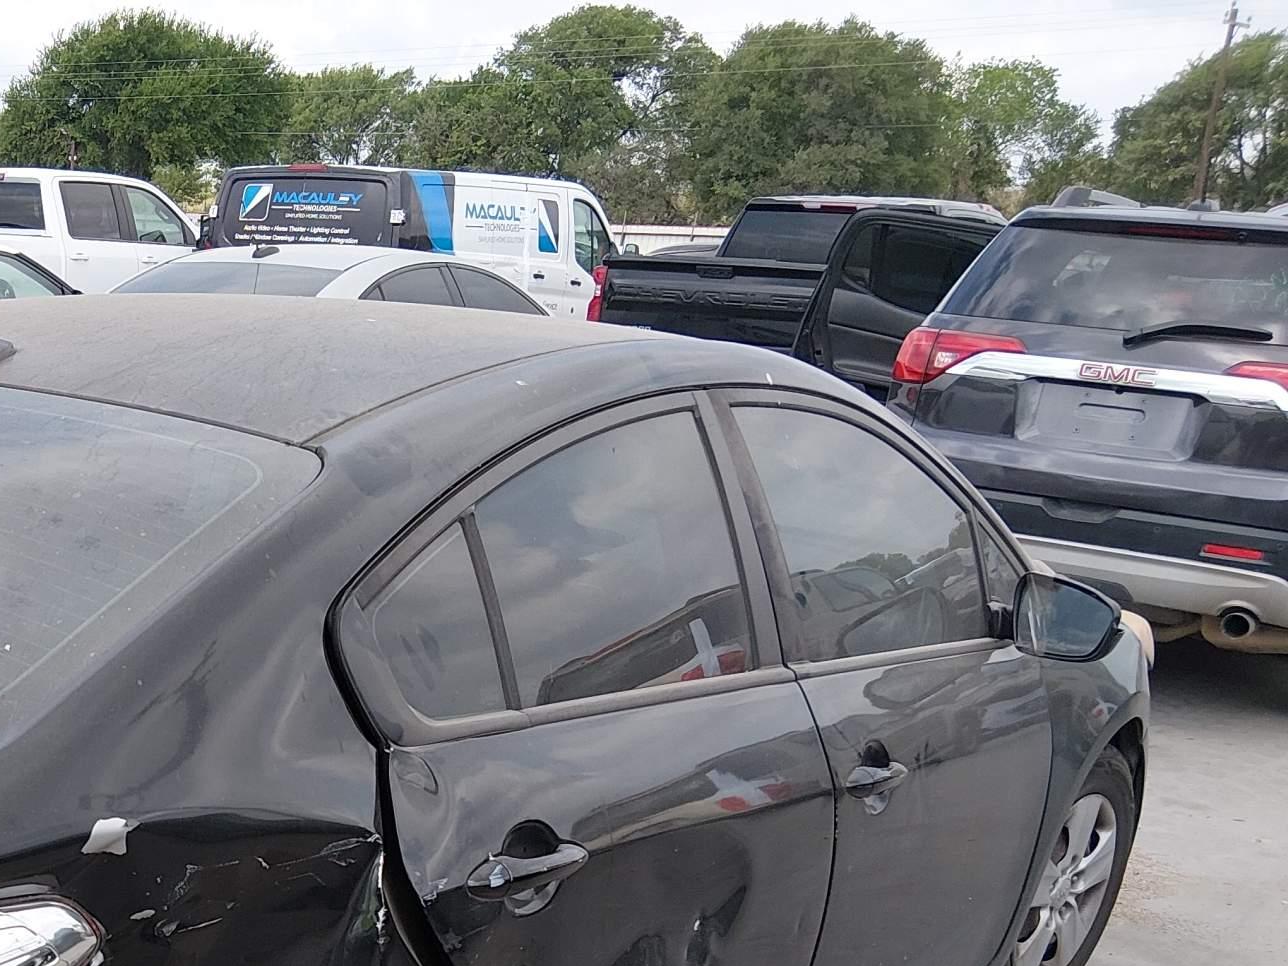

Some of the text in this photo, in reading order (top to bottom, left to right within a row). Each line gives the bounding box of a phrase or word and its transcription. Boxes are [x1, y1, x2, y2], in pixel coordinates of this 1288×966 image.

[273, 191, 364, 205] MACAULEY
[293, 204, 337, 213] TECHNOLOGIES
[1078, 362, 1158, 387] GMC
